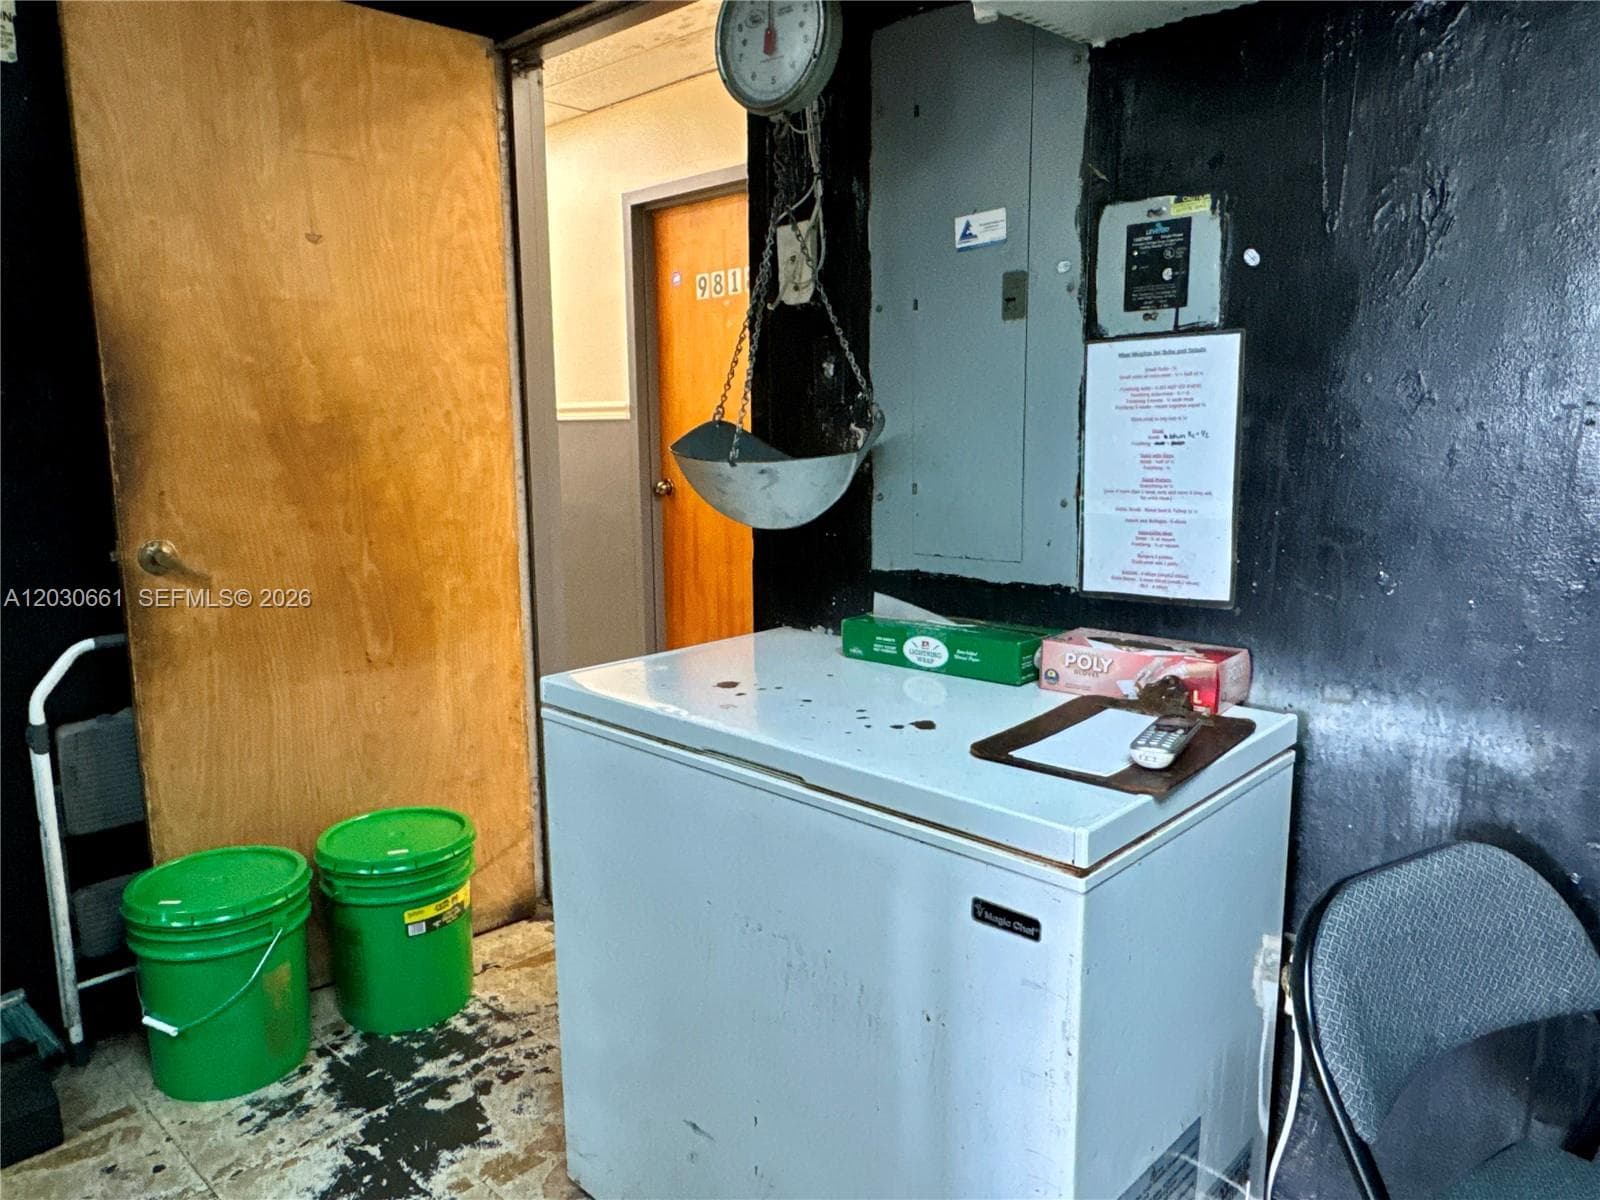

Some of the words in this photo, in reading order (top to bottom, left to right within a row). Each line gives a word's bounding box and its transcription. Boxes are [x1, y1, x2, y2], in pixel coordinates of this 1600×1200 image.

[1065, 652, 1114, 674] POLY
[984, 911, 1012, 928] Magic
[1012, 921, 1036, 937] Chef
